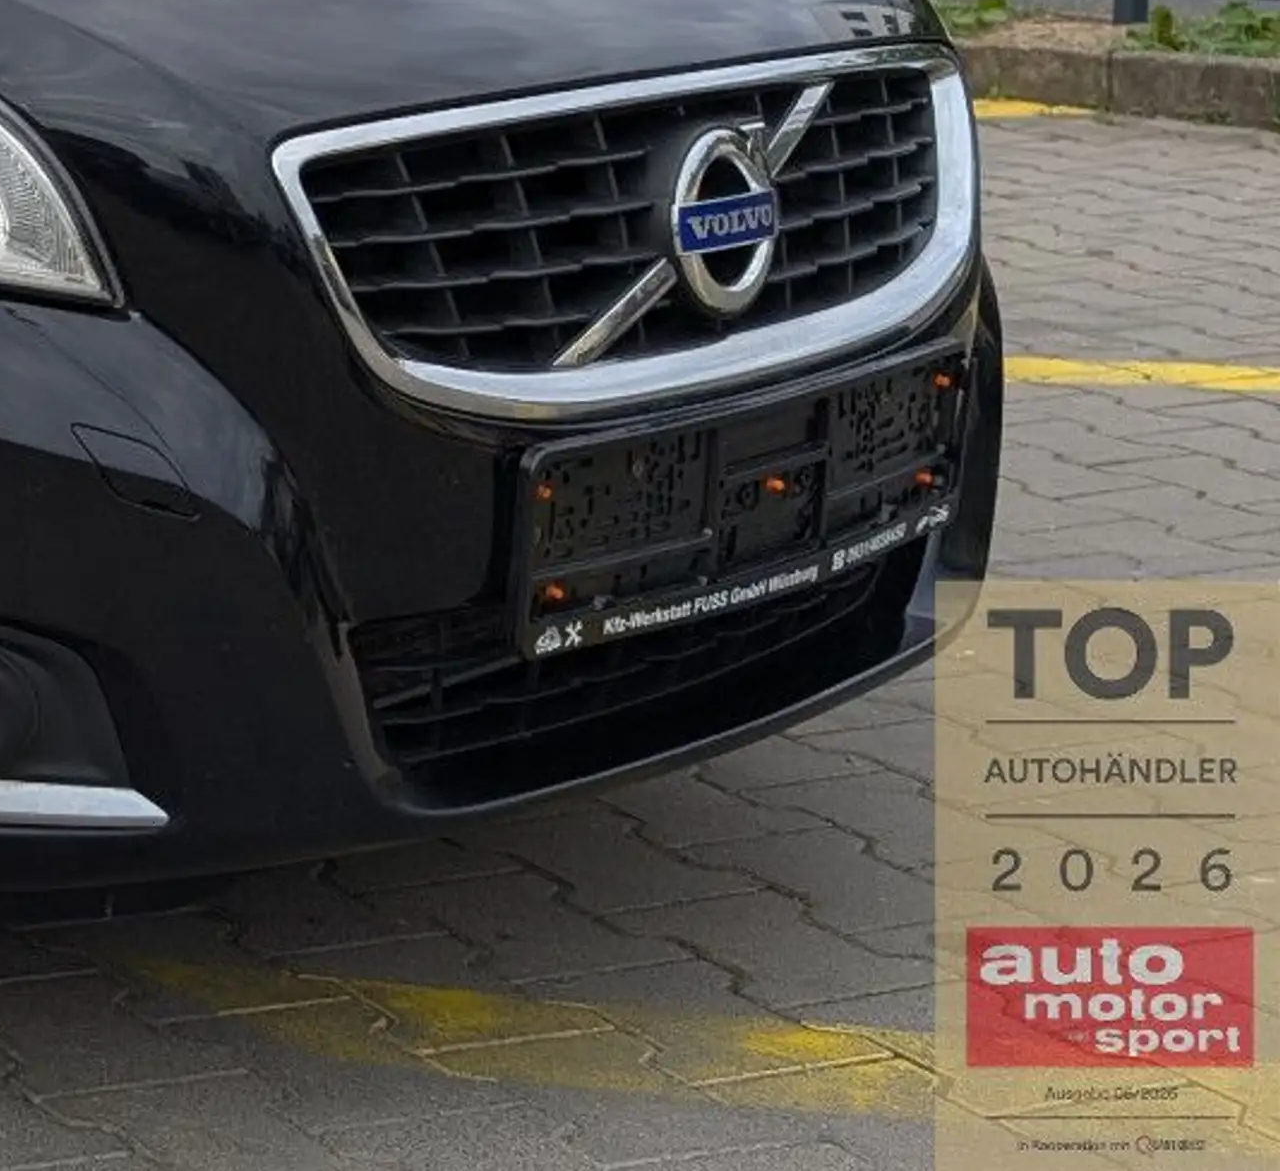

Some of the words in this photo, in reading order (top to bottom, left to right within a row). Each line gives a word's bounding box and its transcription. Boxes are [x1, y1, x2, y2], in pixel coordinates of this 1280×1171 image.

[686, 203, 773, 241] VOLVO
[692, 590, 728, 616] FUSS
[730, 578, 768, 605] GmbH
